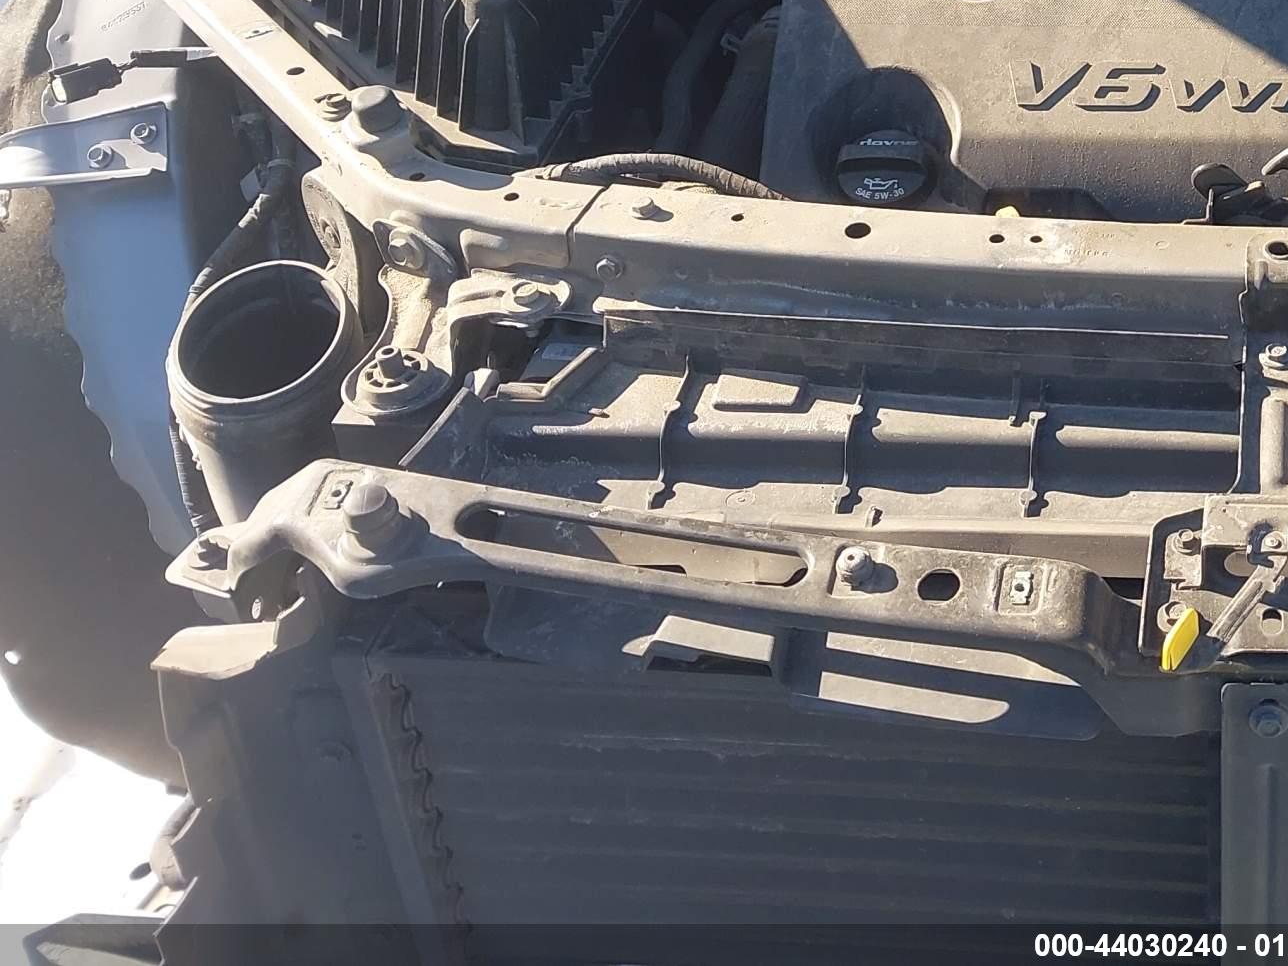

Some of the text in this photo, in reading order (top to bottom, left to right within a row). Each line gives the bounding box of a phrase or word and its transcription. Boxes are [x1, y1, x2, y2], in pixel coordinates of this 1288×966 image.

[1008, 62, 1167, 112] V6
[855, 187, 905, 200] SAE 5W-30
